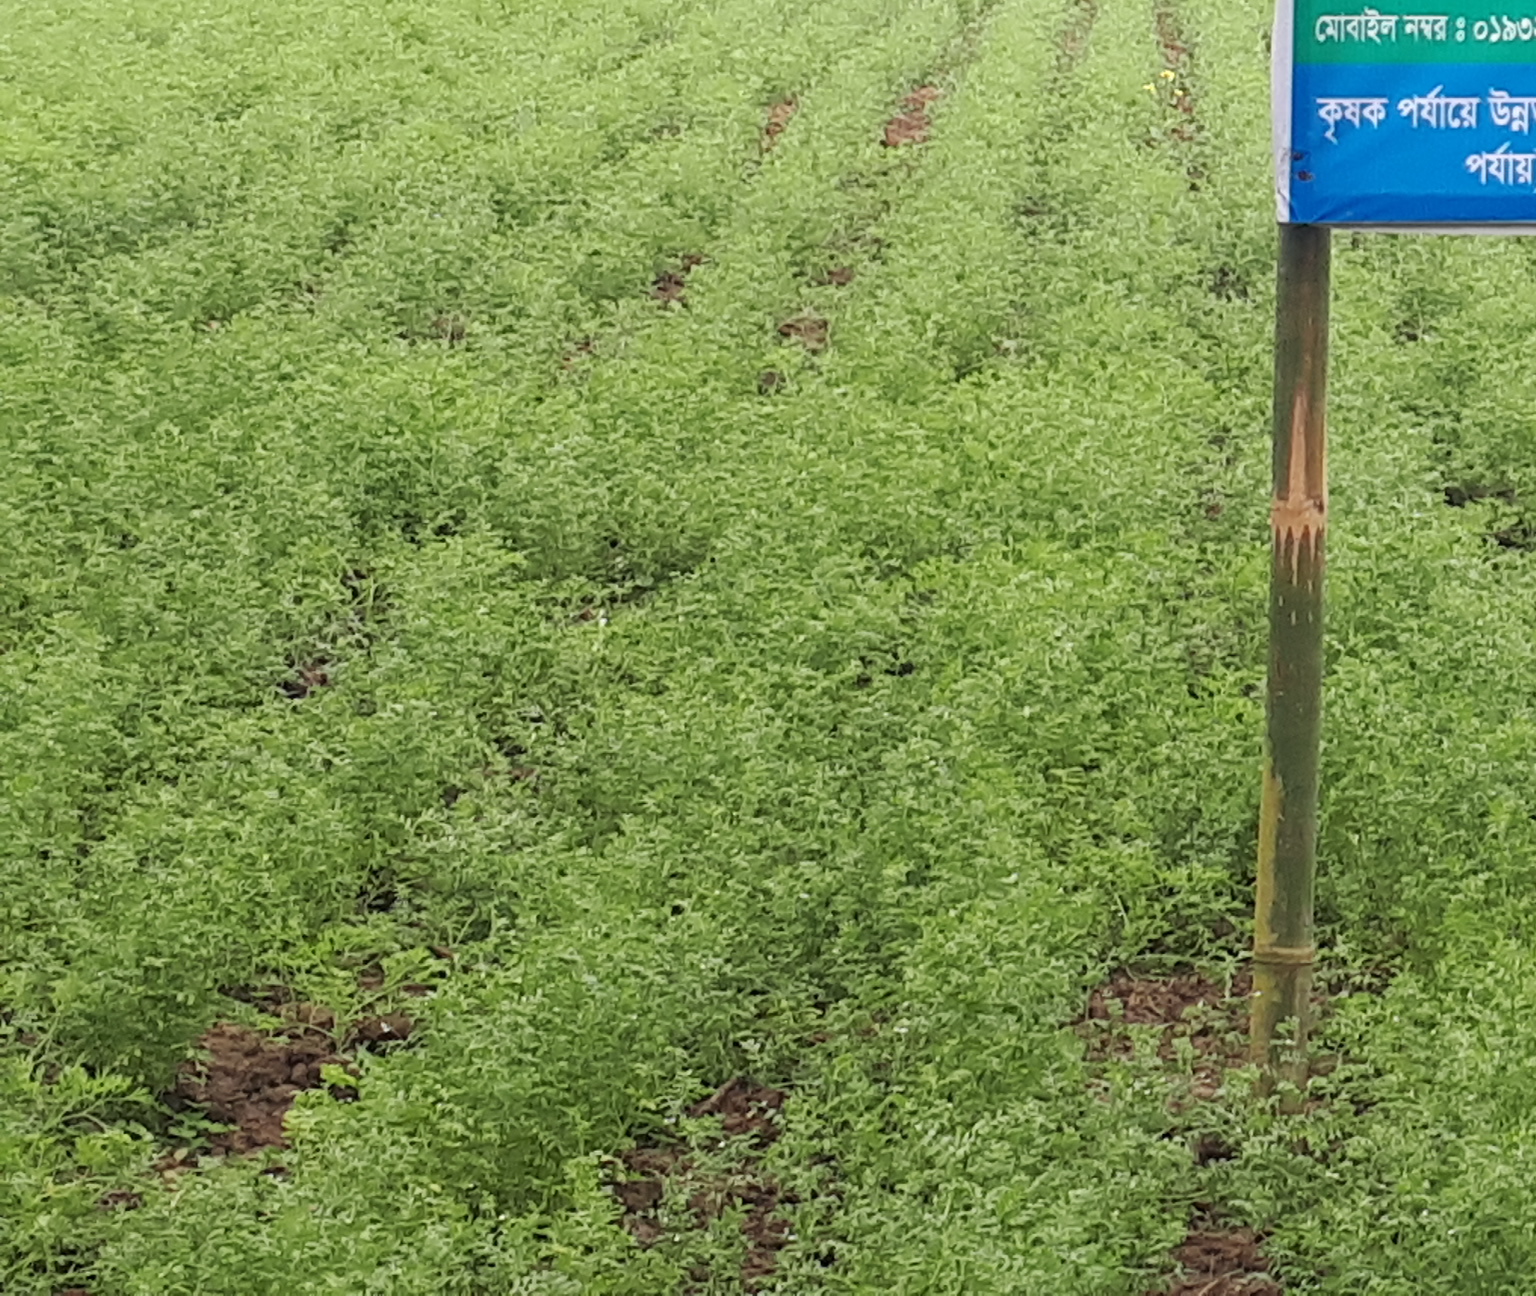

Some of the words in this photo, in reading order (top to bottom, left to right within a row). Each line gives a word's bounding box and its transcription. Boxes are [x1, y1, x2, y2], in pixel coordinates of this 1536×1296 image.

[1315, 7, 1400, 43] মোবাইল
[1401, 14, 1449, 41] নম্বর
[1315, 97, 1389, 143] কৃষক
[1396, 85, 1482, 129] পর্যায়ে
